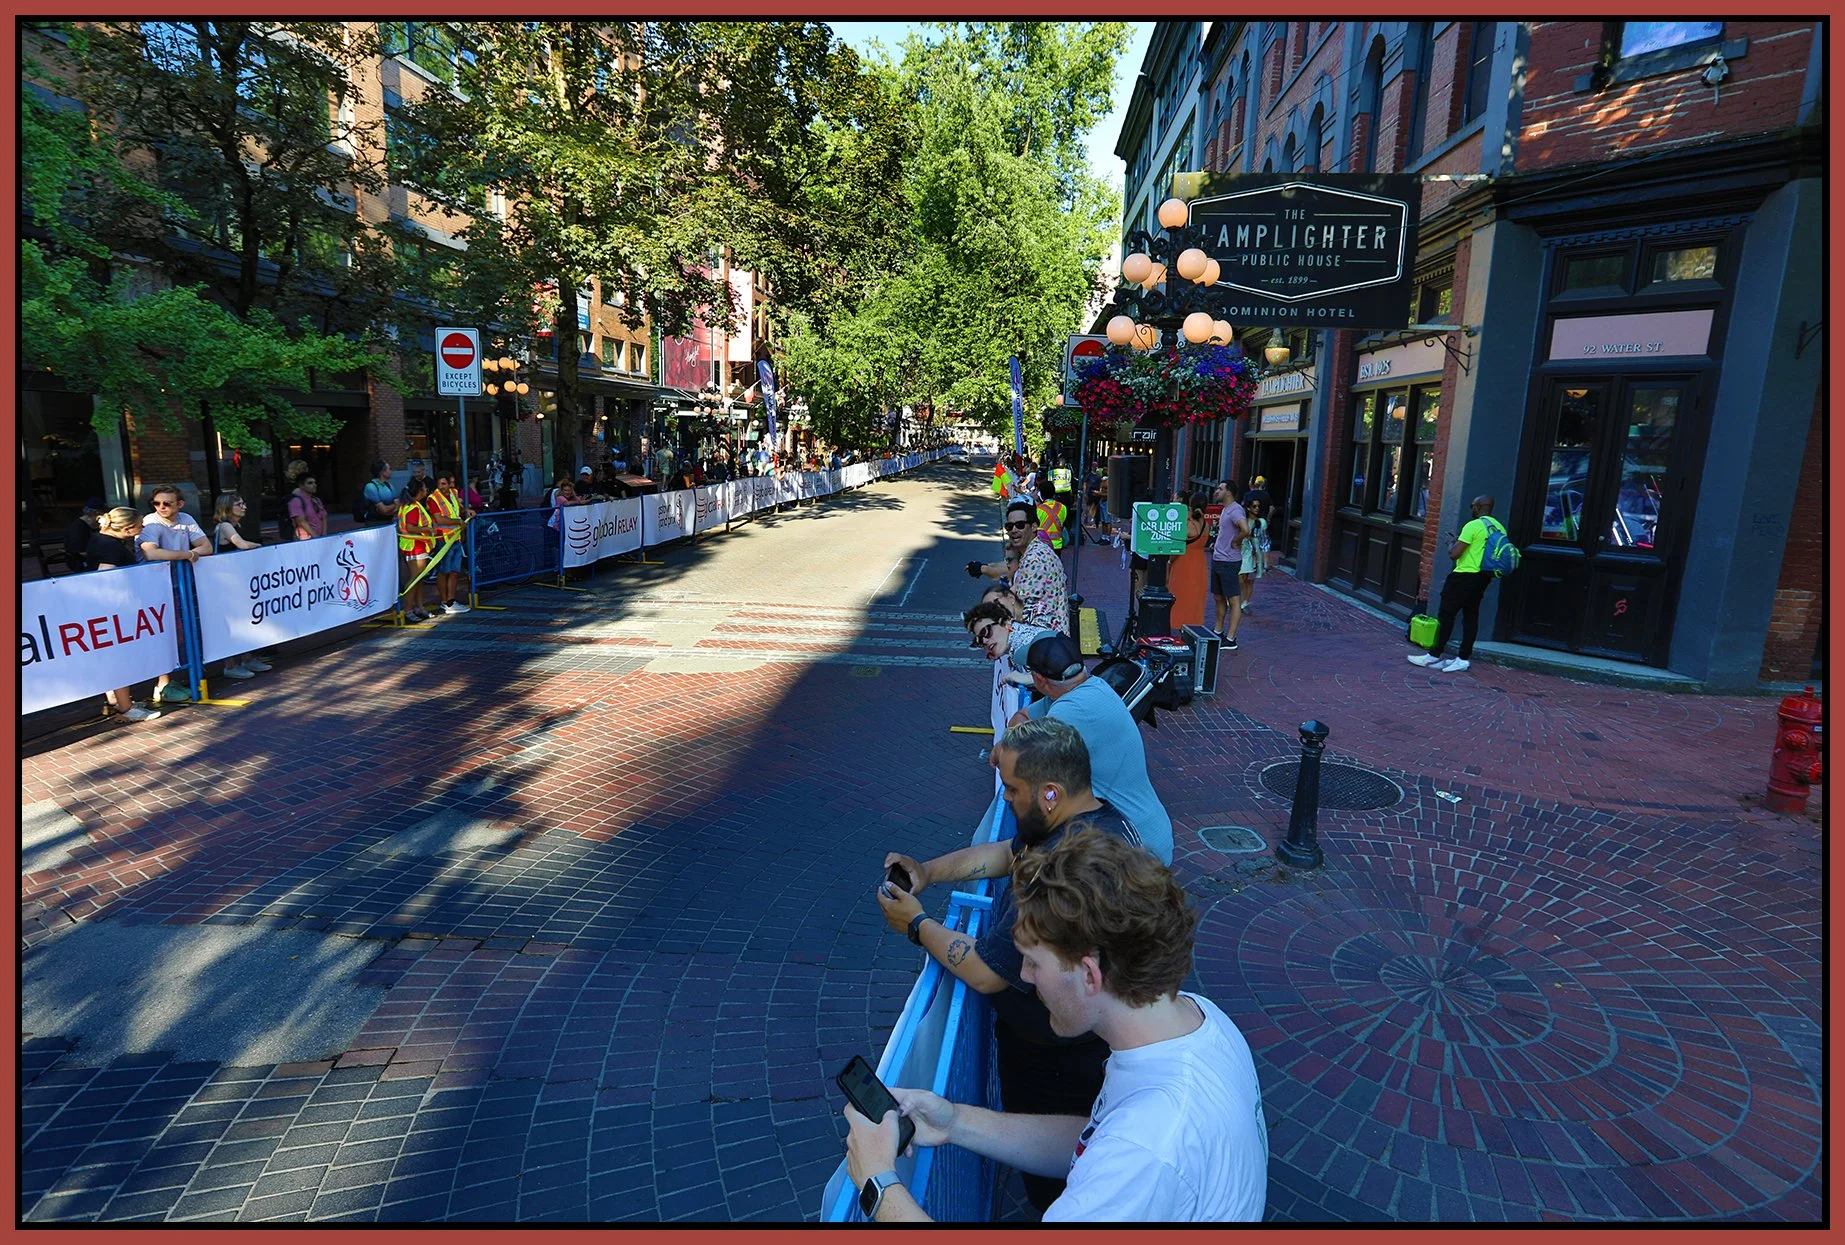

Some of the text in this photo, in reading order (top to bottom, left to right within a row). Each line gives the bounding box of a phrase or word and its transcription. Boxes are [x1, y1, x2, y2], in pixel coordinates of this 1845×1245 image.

[1285, 209, 1306, 220] THE
[1241, 254, 1341, 267] PUBLIC HOUSE
[1287, 276, 1309, 284] 1899
[1306, 307, 1355, 318] HOTEL
[1583, 342, 1664, 354] 92 WATER ST.
[442, 380, 477, 388] BICYCLES
[618, 516, 638, 534] RELAY
[1140, 521, 1182, 531] CAR LIGHT
[1150, 531, 1171, 540] ZONE
[250, 563, 320, 599] gastown
[251, 581, 335, 625] grand prix
[58, 603, 167, 656] RELAY
